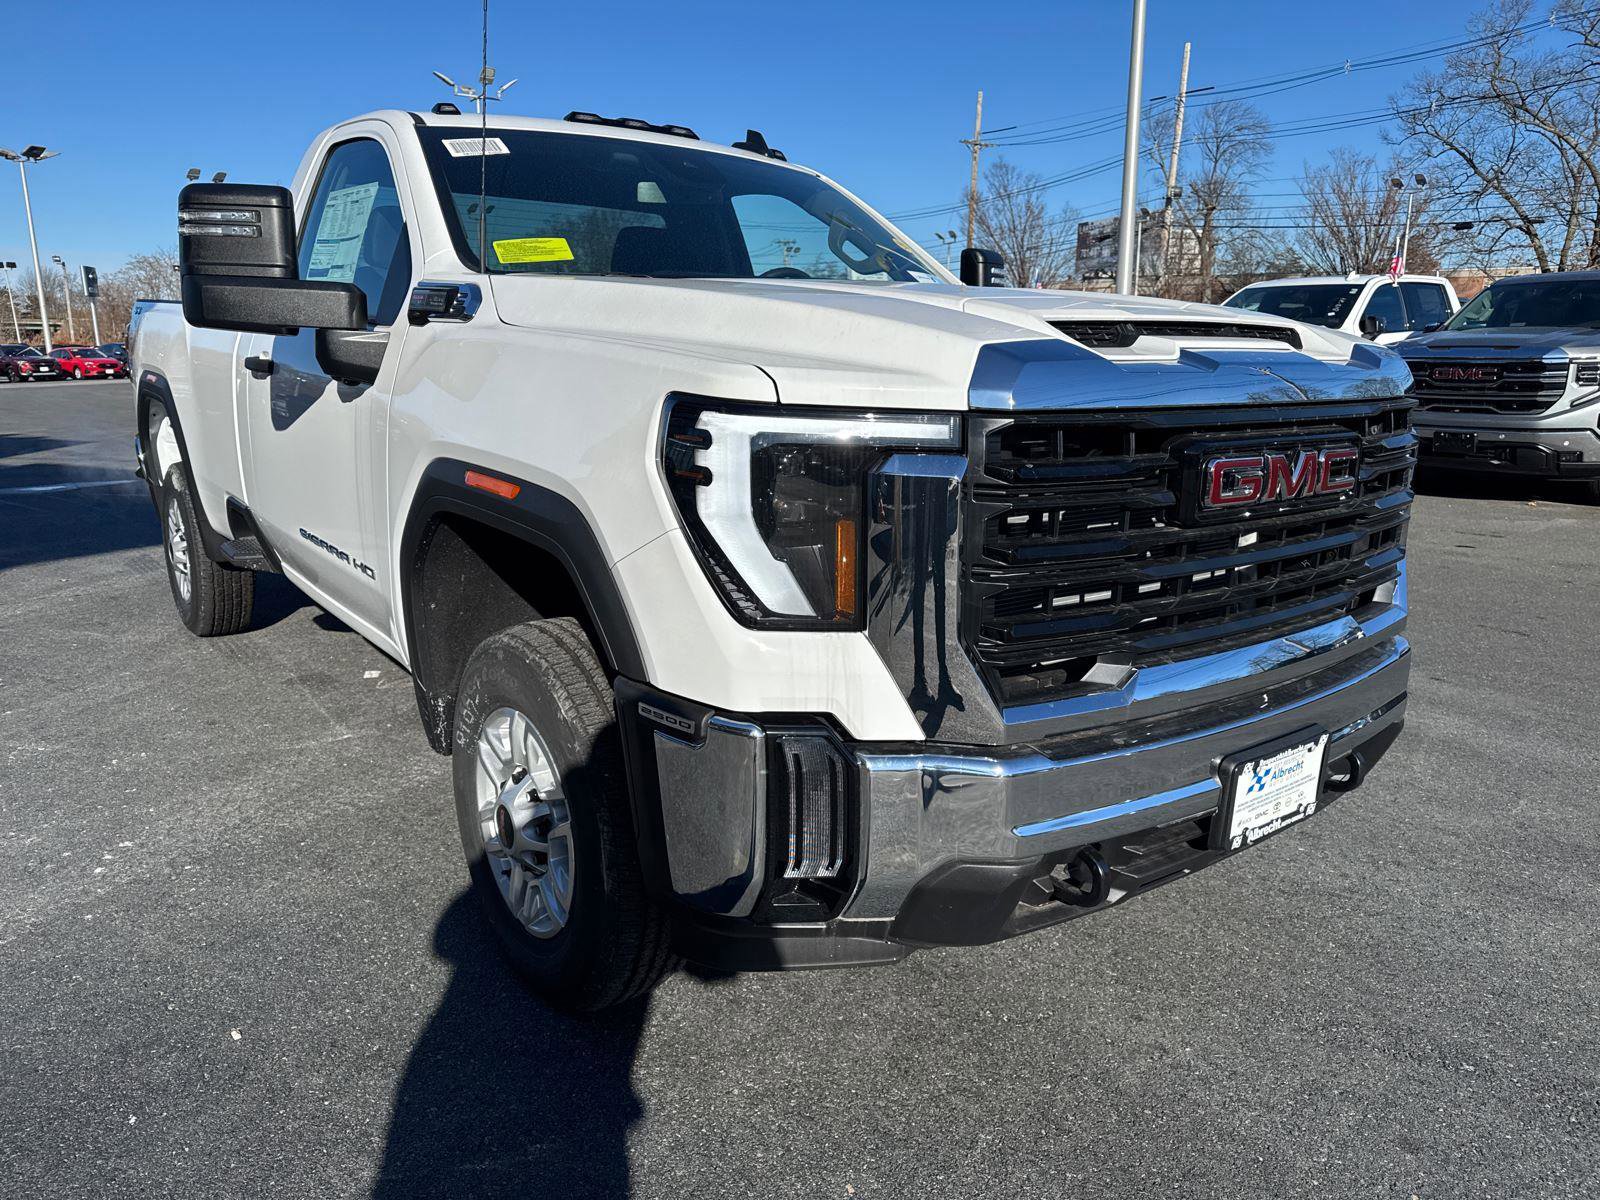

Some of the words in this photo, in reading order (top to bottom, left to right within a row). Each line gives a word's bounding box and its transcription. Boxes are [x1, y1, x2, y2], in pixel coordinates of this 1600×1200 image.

[1433, 367, 1499, 380] GMC
[1203, 449, 1358, 505] GMC
[299, 528, 350, 565] SIERRA
[353, 558, 376, 580] HD
[640, 706, 692, 729] 2500
[1270, 760, 1304, 781] Albrecht
